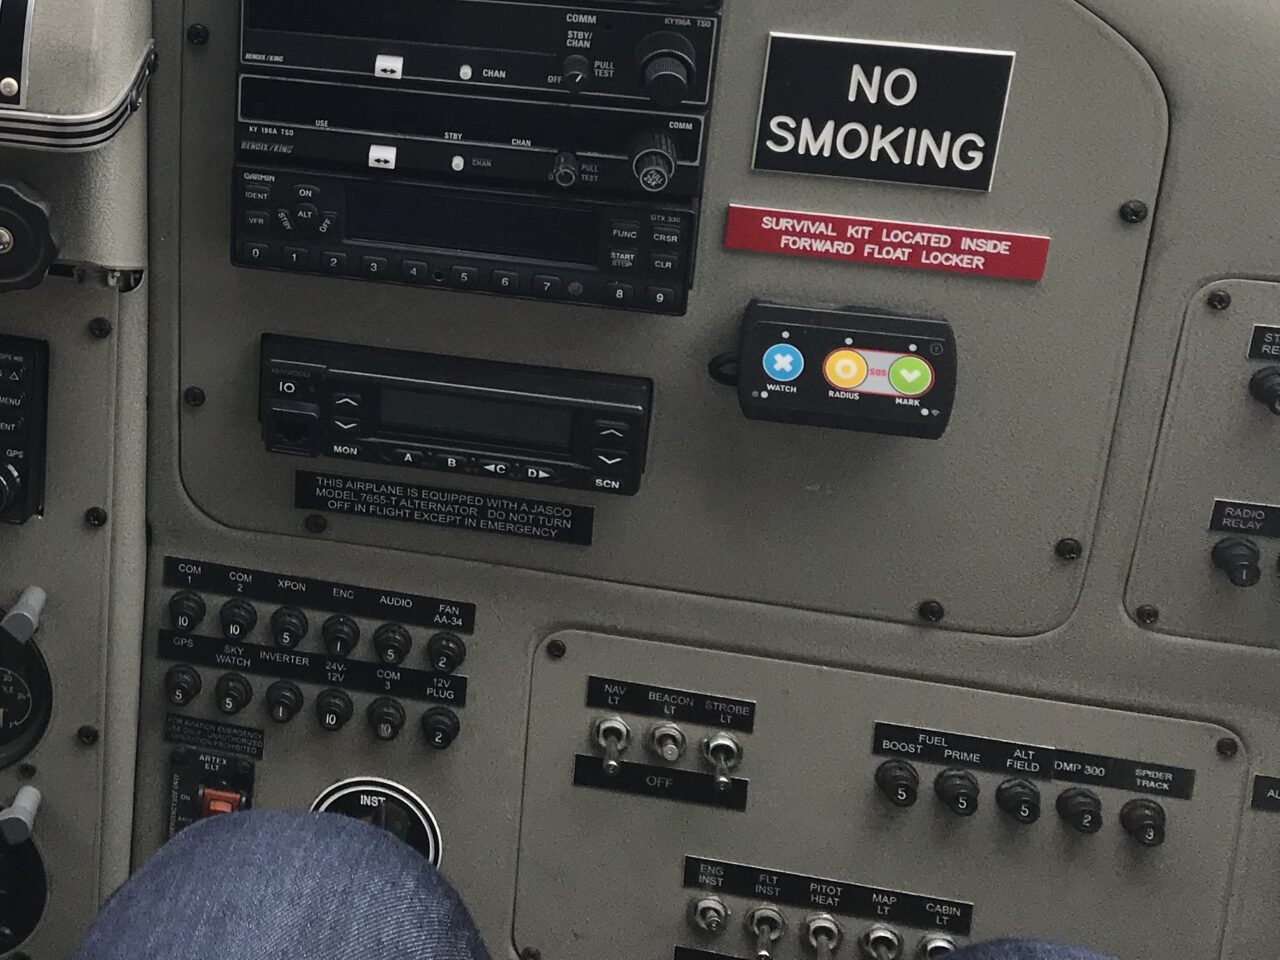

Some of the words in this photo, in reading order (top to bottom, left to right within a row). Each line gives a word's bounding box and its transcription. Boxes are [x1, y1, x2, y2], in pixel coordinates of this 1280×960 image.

[566, 13, 597, 24] COMM
[567, 30, 593, 40] STBY/
[566, 39, 591, 48] CHAN
[594, 60, 615, 70] PULL
[482, 68, 506, 79] CHAN
[593, 69, 615, 78] TEST
[847, 63, 918, 107] NO
[669, 121, 693, 130] COMM
[765, 115, 986, 172] SMOKING
[613, 230, 637, 239] FUNC
[653, 233, 678, 243] CRSR
[761, 216, 838, 237] SURVIVAL
[847, 225, 873, 240] KIT
[881, 228, 952, 248] LOCATED
[960, 237, 1012, 255] INSIDE
[780, 235, 855, 256] FORWARD
[863, 244, 912, 262] FLOAT
[921, 250, 985, 270] LOCKER
[869, 367, 887, 377] SOS
[766, 383, 797, 393] WATCH
[828, 390, 860, 400] RADIUS
[895, 397, 920, 407] MARK
[333, 445, 358, 456] MON
[595, 478, 620, 490] SCN
[316, 476, 344, 489] THIS
[345, 480, 404, 497] AIRPLANE
[407, 487, 419, 498] IS
[421, 489, 484, 506] EQUIPPED
[486, 498, 518, 510] WITH
[520, 502, 529, 511] A
[531, 503, 572, 518] JASCO
[315, 488, 358, 501] MODEL
[360, 493, 397, 506] 7655-T
[399, 498, 478, 517] ALTERNATOR
[487, 509, 506, 519] DO
[508, 512, 536, 525] NOT
[538, 516, 572, 529] TURN
[1225, 507, 1265, 520] RADIO
[327, 499, 353, 510] OFF
[355, 503, 366, 512] IN
[369, 505, 411, 519] FLIGHT
[414, 510, 463, 525] EXCEPT
[465, 516, 477, 527] IN
[479, 519, 558, 537] EMERGENCY
[1222, 518, 1264, 530] RELAY
[178, 563, 202, 574] COM
[229, 571, 253, 583] COM
[278, 579, 306, 592] XPON
[332, 587, 354, 599] ENC
[379, 595, 413, 609] AUDIO
[439, 604, 460, 616] FAN
[433, 614, 463, 628] AA-34
[172, 636, 194, 648] GPS
[223, 644, 245, 656] SKY
[215, 653, 251, 668] WATCH
[259, 650, 310, 667] INVERTER
[376, 668, 401, 681] COM
[432, 678, 451, 688] 12V
[605, 684, 626, 695] NAV
[426, 687, 455, 700] PLUG
[648, 692, 694, 706] BEACON
[705, 701, 750, 715] STROBE
[882, 739, 923, 754] BOOST
[918, 734, 948, 747] FUEL
[944, 749, 981, 763] PRIME
[1013, 748, 1036, 761] ALT
[1006, 759, 1040, 773] FIELD
[1054, 759, 1083, 775] DMP
[1084, 763, 1106, 777] 300
[1135, 768, 1173, 782] SPIDER
[646, 776, 673, 788] OFF
[1136, 778, 1170, 791] TRACK
[360, 794, 386, 807] INST
[700, 864, 724, 876] ENG
[699, 874, 724, 887] INST
[755, 884, 781, 897] INST
[810, 882, 843, 896] PITOT
[811, 893, 841, 906] HEAT
[872, 894, 897, 906] MAP
[926, 902, 961, 916] CABIN
